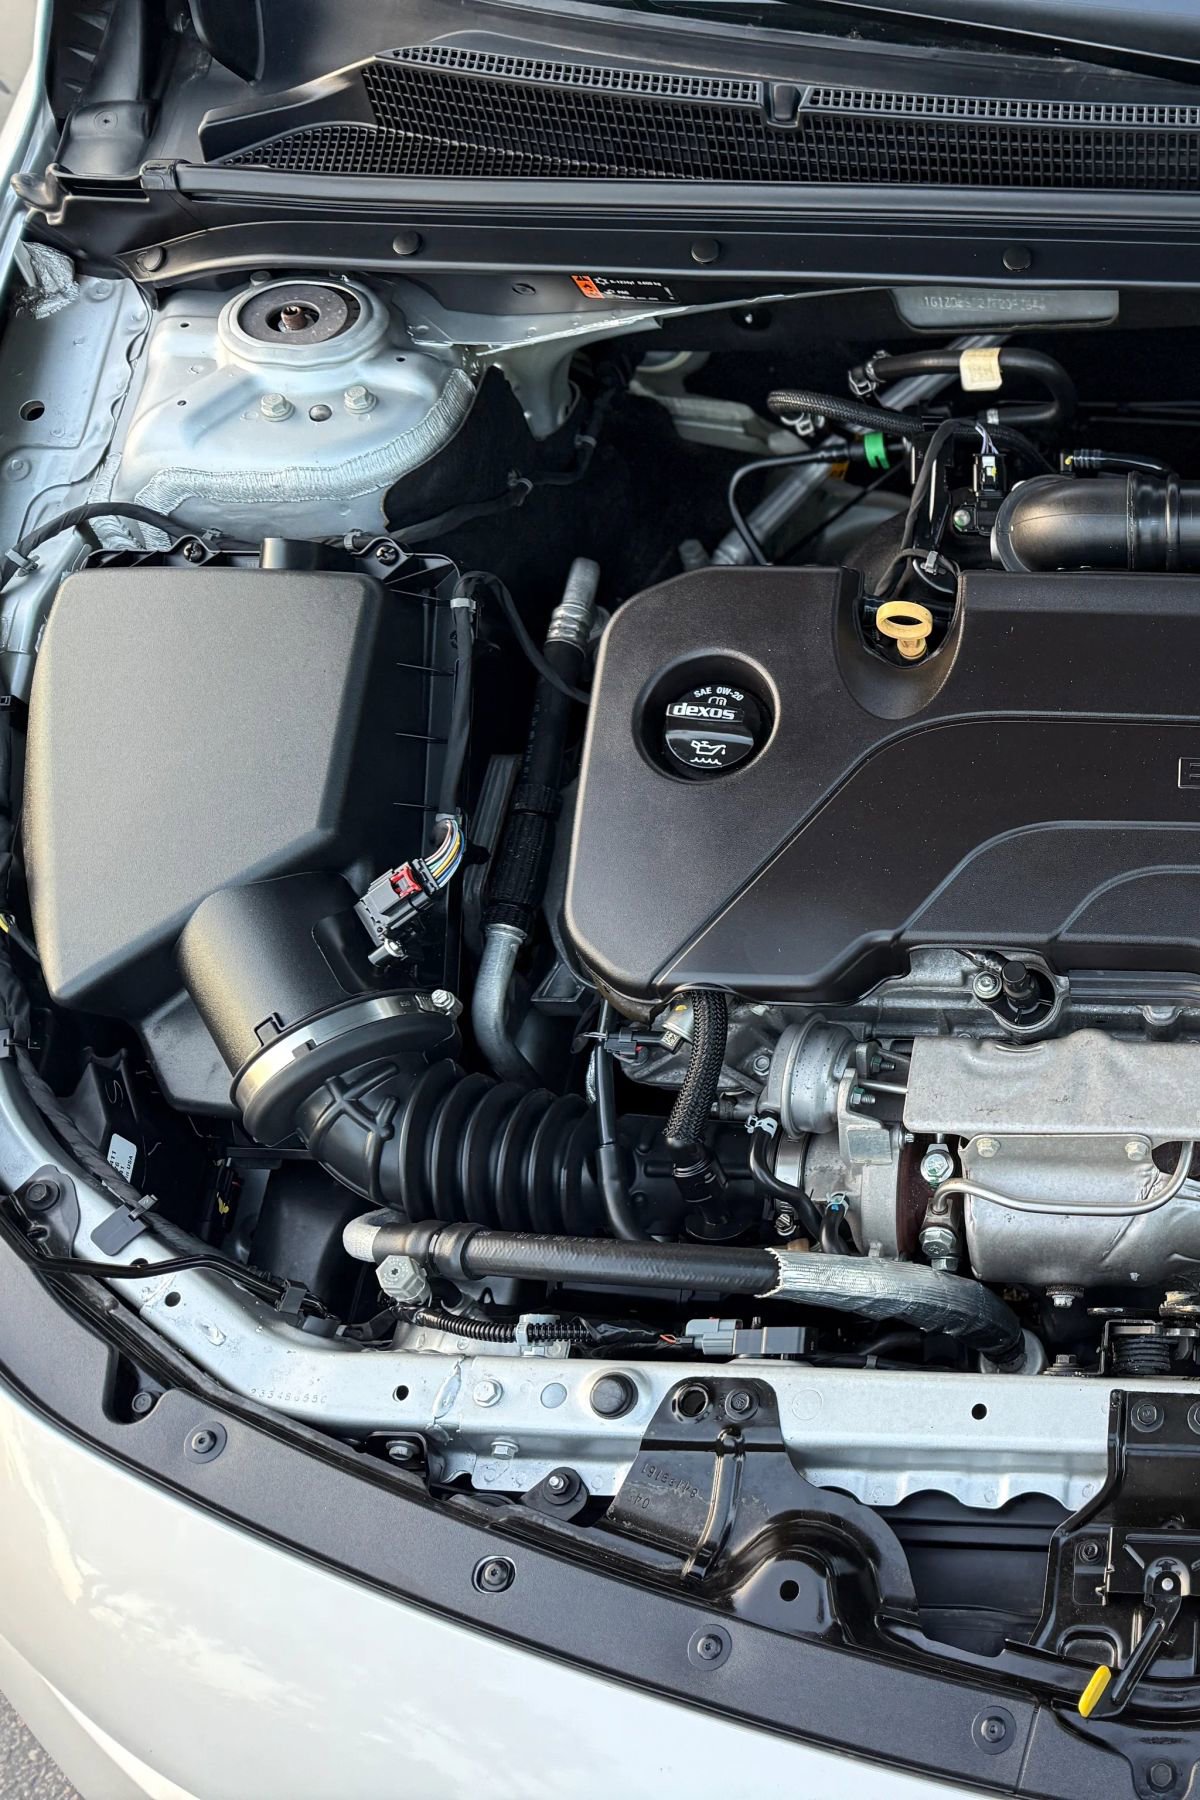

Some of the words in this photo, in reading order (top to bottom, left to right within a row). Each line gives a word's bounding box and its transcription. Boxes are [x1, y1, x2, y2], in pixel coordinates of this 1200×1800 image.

[694, 686, 712, 698] SAE
[716, 686, 744, 702] 0W-20
[673, 703, 735, 720] dexos
